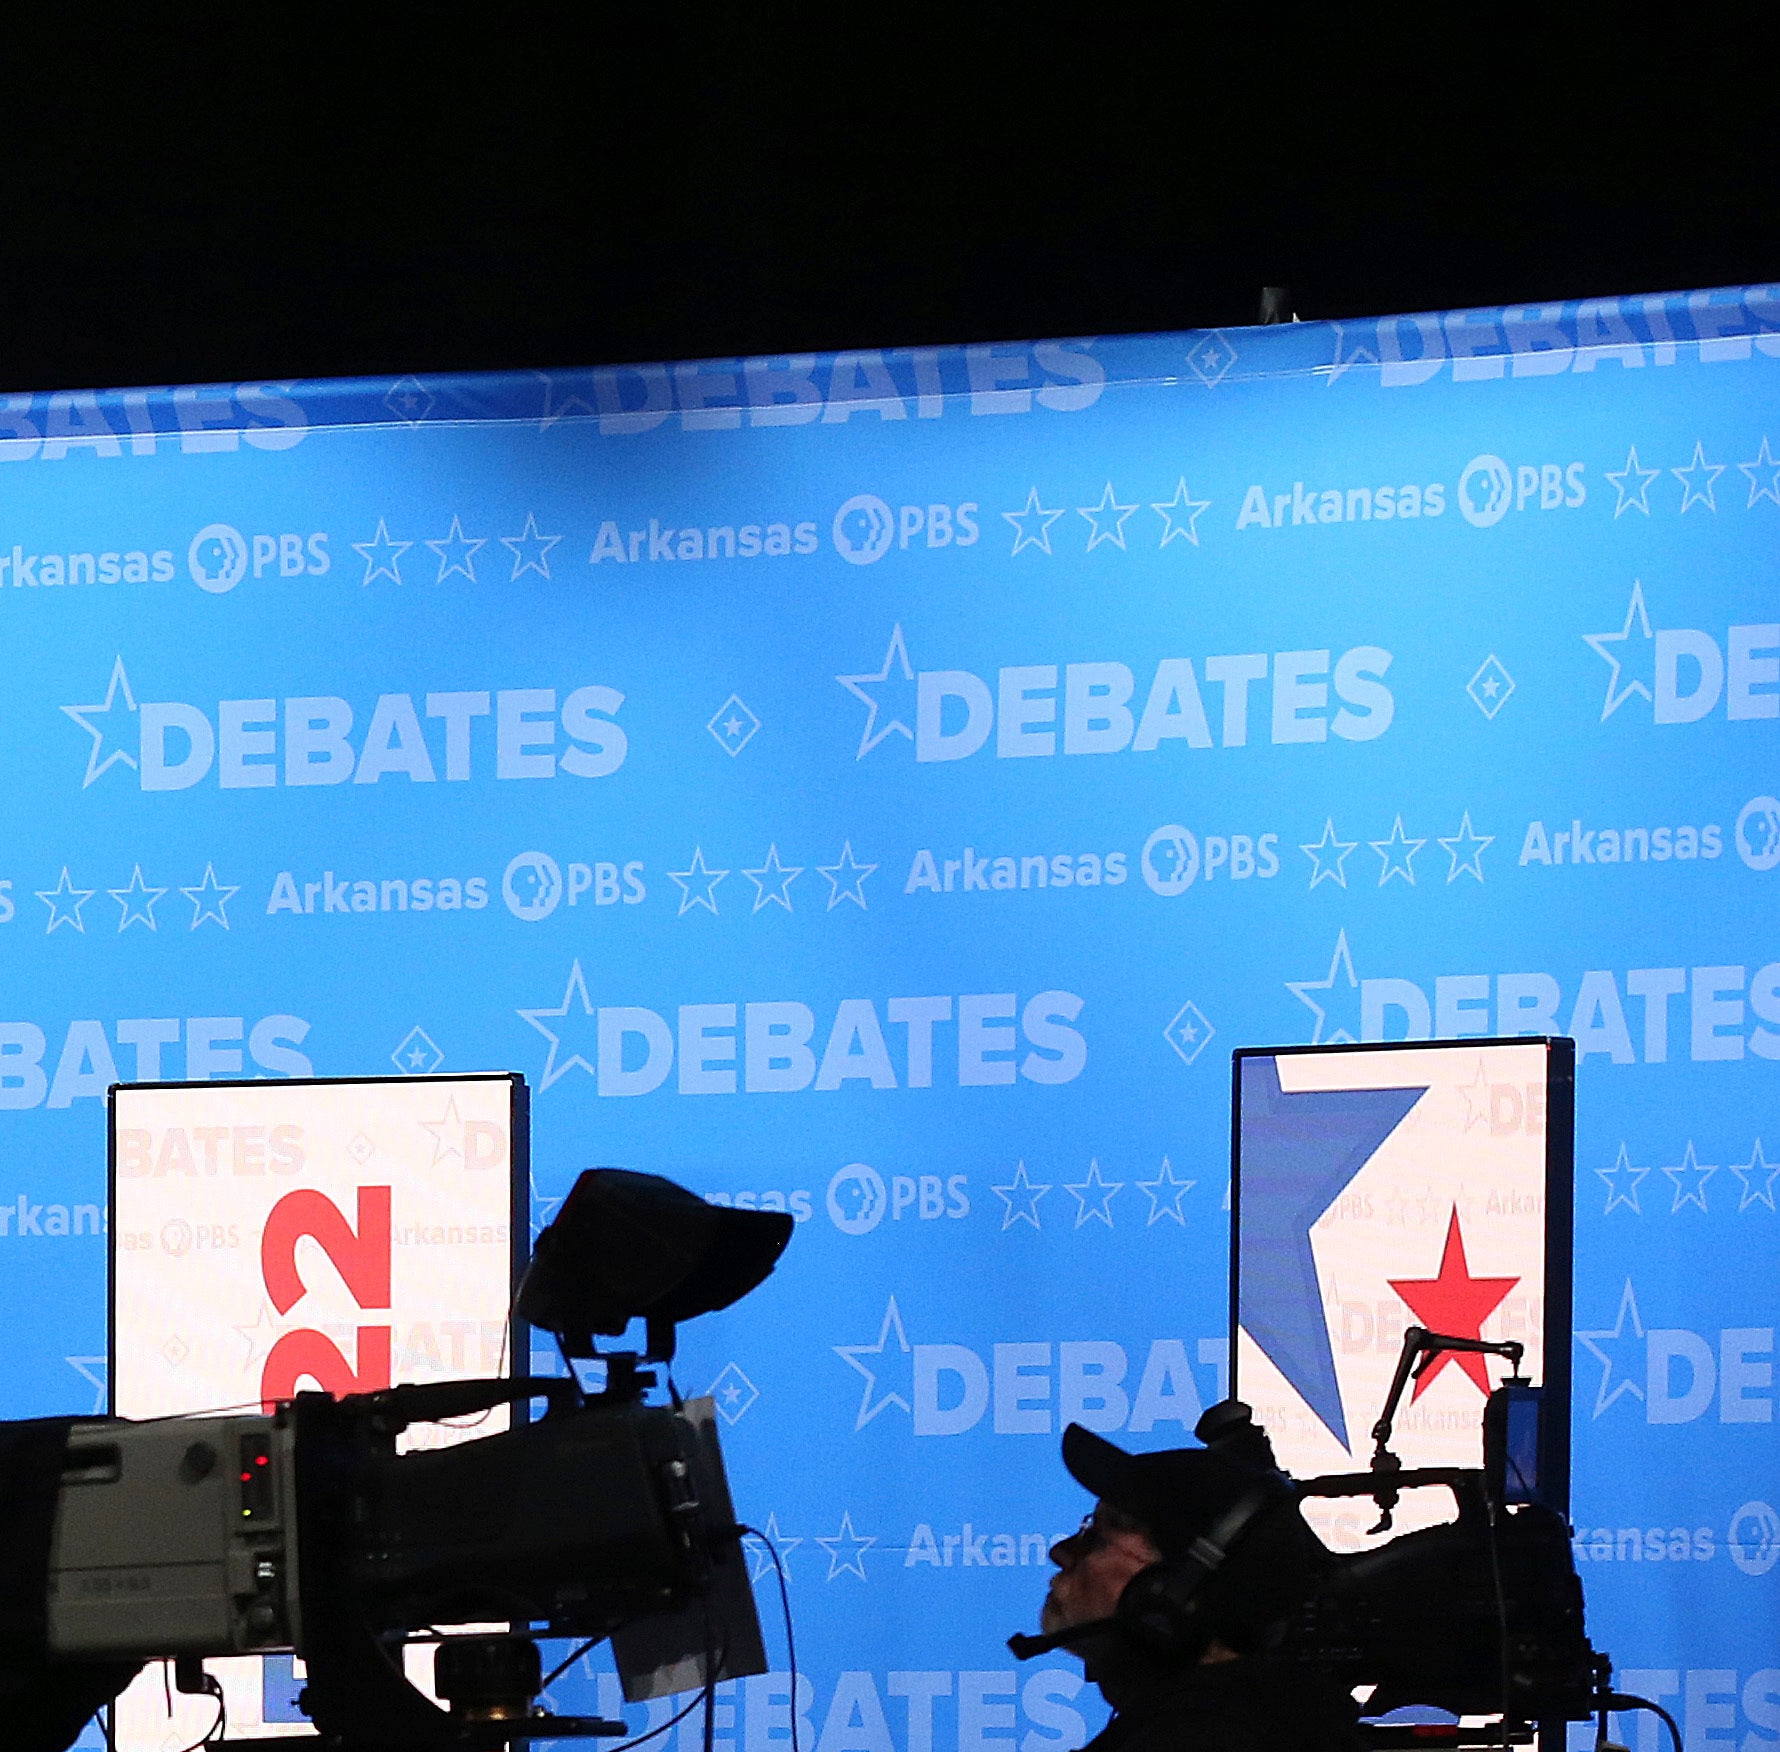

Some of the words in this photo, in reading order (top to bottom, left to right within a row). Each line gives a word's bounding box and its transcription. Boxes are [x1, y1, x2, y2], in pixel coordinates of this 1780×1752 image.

[597, 338, 1104, 437] DEBATES
[1235, 483, 1444, 531] Arkansas
[1517, 462, 1585, 510] PBS
[253, 533, 330, 578] PBS
[589, 514, 817, 564] Arkansas
[900, 502, 979, 549] PBS
[917, 646, 1395, 762] DEBATES
[140, 684, 628, 792] DEBATES
[905, 848, 1126, 894] Arkansas
[1203, 834, 1278, 882] PBS
[1518, 819, 1722, 868] Arkansas
[266, 872, 488, 915] Arkansas
[568, 861, 645, 908] PBS
[598, 989, 1086, 1097] DEBATES
[119, 1124, 305, 1178] BATES
[893, 1174, 970, 1221] PBS
[196, 1223, 239, 1249] PBS
[913, 1339, 1232, 1436] DEBAT
[904, 1523, 1050, 1567] Arkan
[1572, 1526, 1715, 1563] kansas
